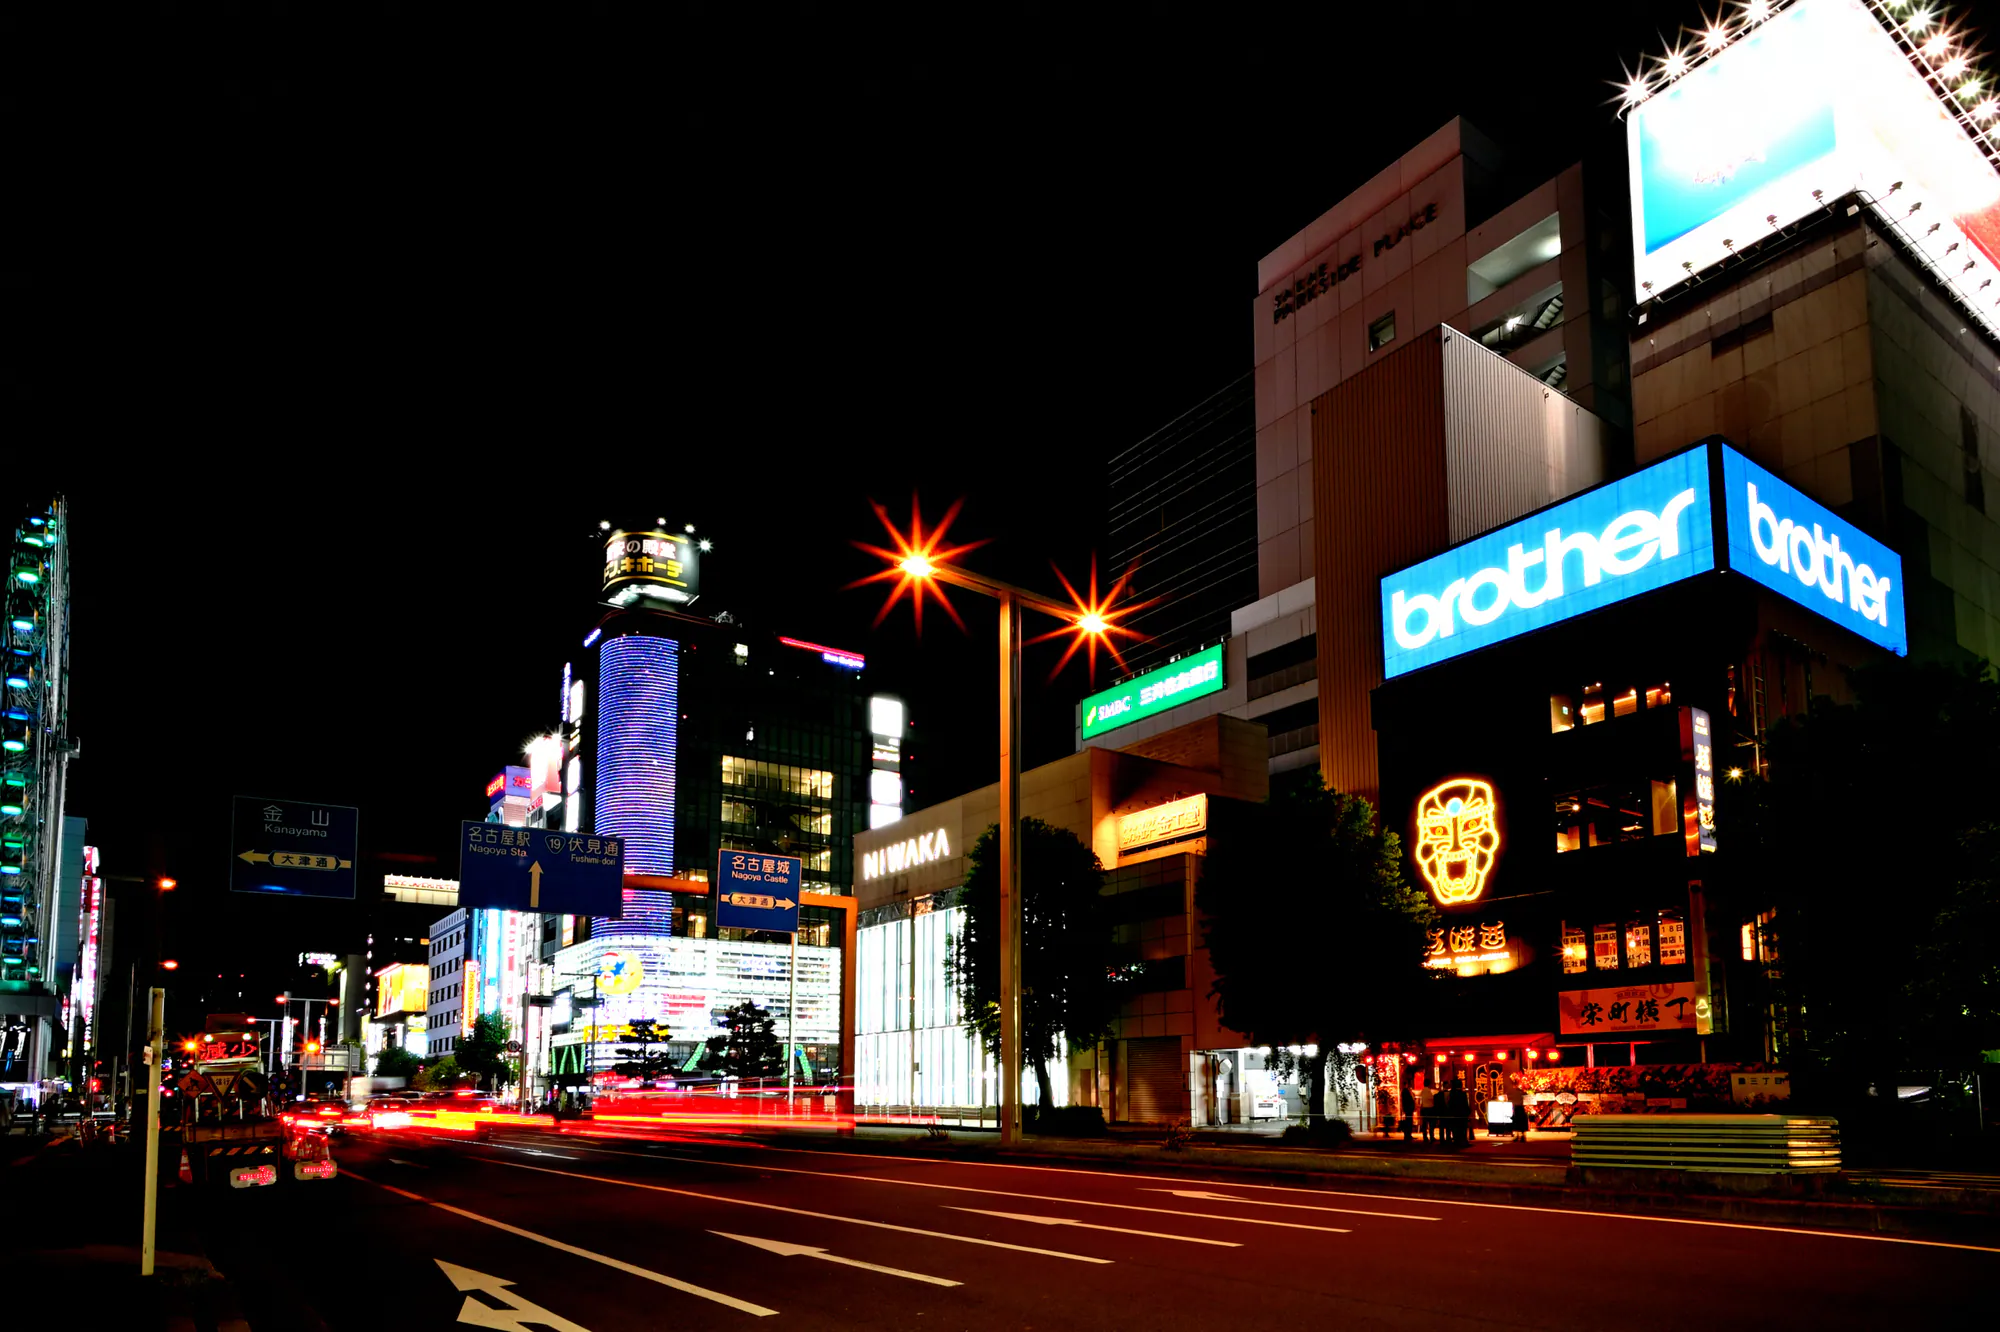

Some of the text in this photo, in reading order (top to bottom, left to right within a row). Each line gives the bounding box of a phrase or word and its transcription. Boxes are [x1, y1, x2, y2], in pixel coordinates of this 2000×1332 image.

[1274, 202, 1439, 324] PARKSIDE PLACE
[606, 539, 676, 563] 安の殿堂
[1747, 481, 1891, 627] brother
[1391, 487, 1695, 650] brother
[1098, 695, 1132, 721] SMBC
[263, 804, 330, 827] 金山
[264, 824, 328, 838] Kanayama
[468, 826, 531, 848] 名古屋駅
[469, 844, 507, 856] Nagoya
[550, 837, 619, 857] 19 伏見通
[863, 827, 950, 881] NIWAKA
[281, 855, 328, 868] 大津通
[571, 853, 616, 866] Fushimi-dori
[731, 855, 791, 875] 名古屋城
[731, 870, 789, 885] Nagoya Castle
[737, 895, 770, 907] 大津通
[1661, 949, 1685, 958] 募集中
[1581, 997, 1689, 1026] 栄町横丁
[199, 1041, 258, 1060] 減少
[1738, 1077, 1783, 1085] 三丁目
